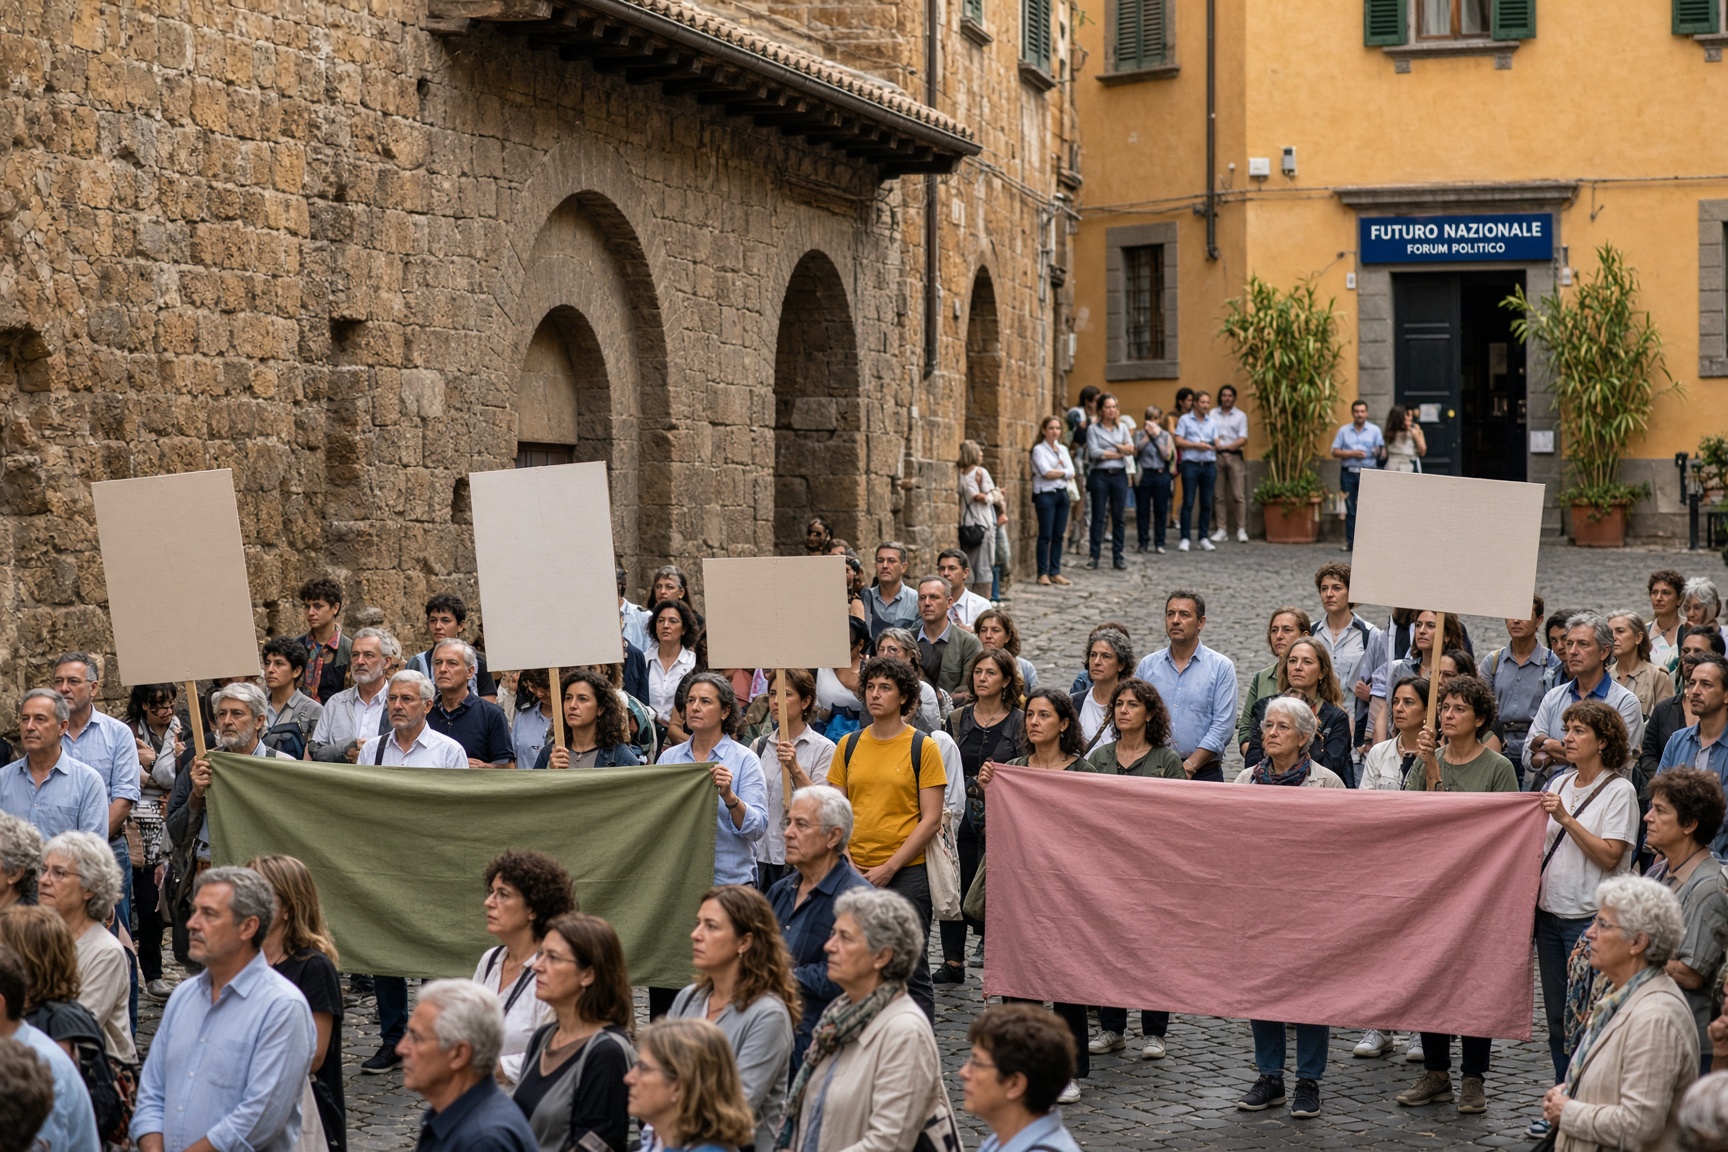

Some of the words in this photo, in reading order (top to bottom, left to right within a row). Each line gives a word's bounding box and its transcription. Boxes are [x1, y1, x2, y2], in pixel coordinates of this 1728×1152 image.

[1371, 224, 1438, 240] FUTURO
[1444, 222, 1542, 238] NAZIONALE
[1407, 244, 1448, 254] FORUM
[1452, 242, 1505, 254] POLITICO
